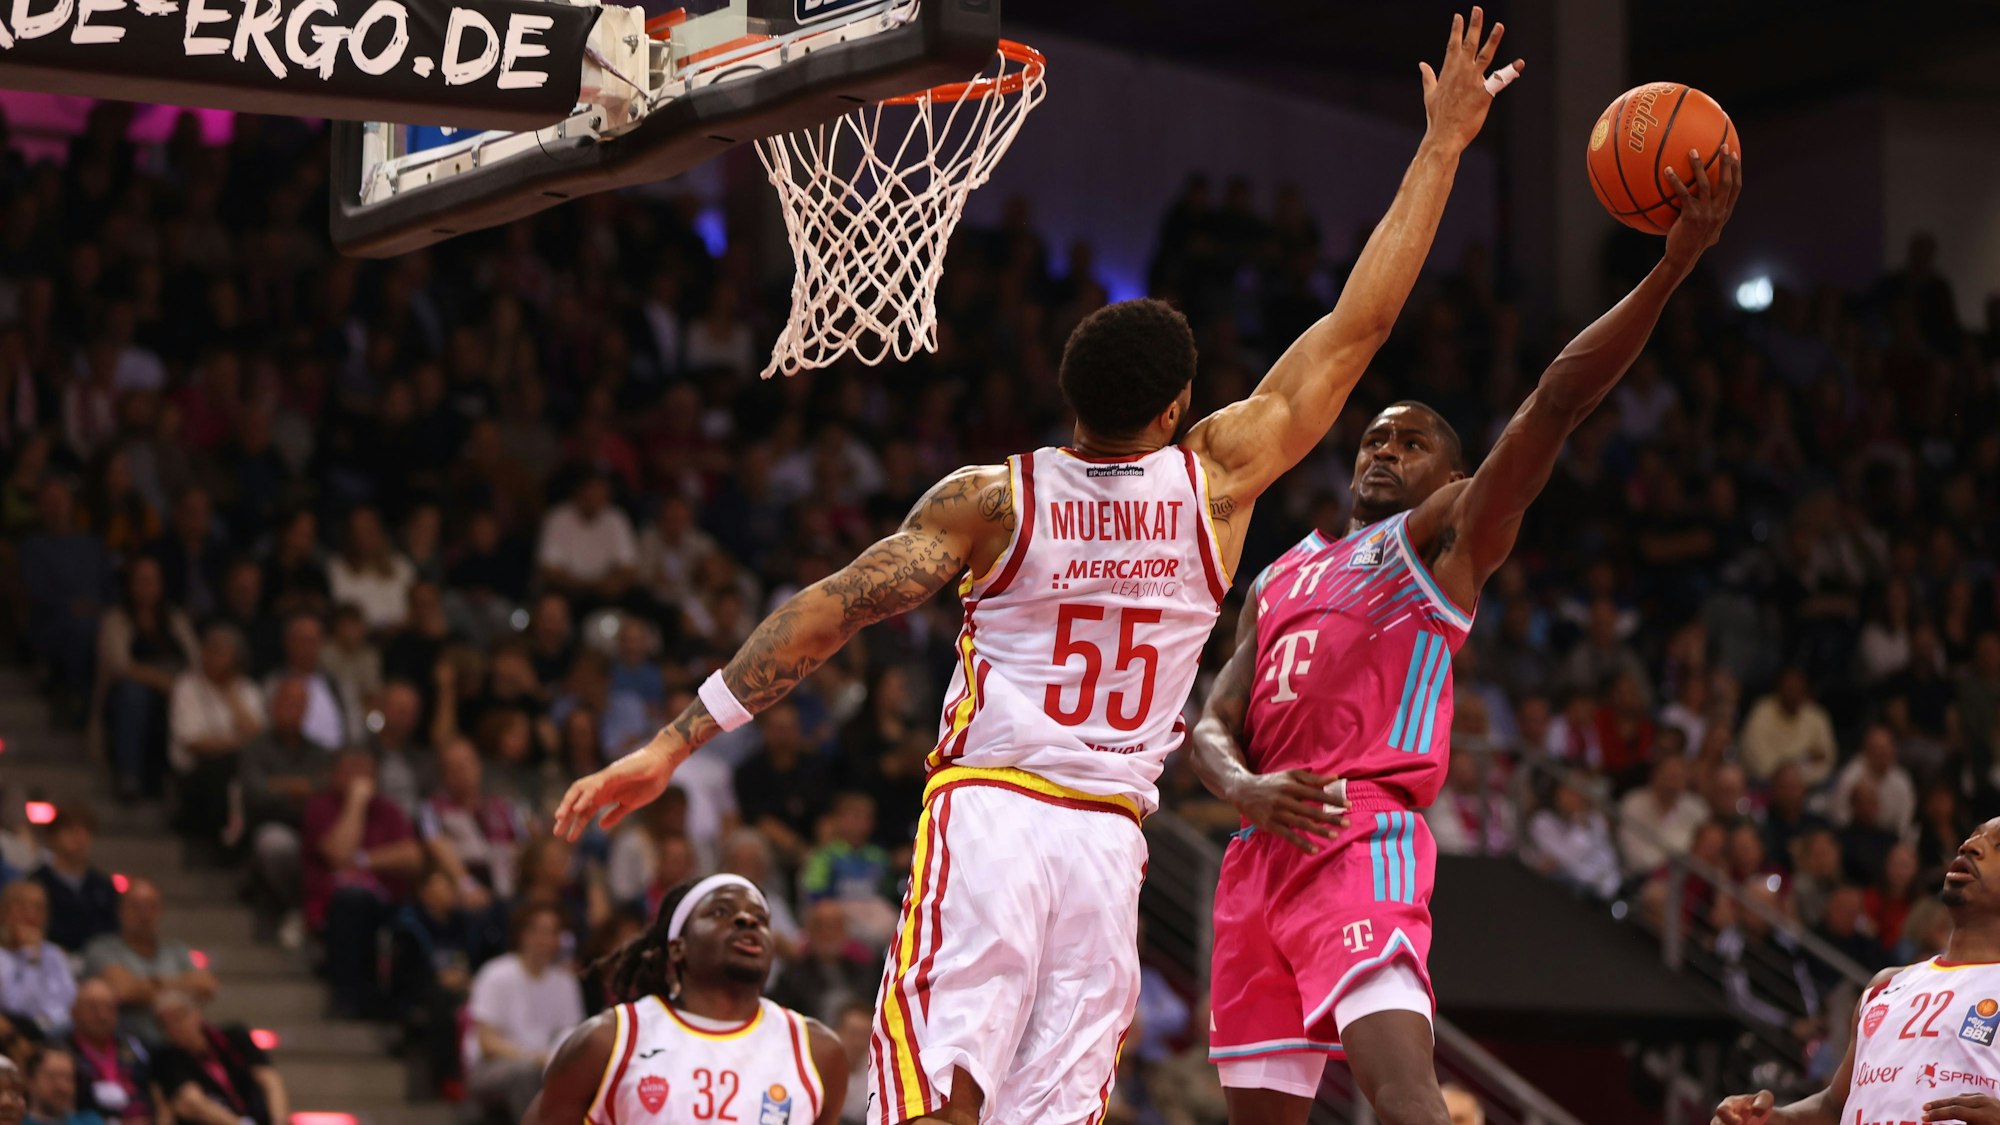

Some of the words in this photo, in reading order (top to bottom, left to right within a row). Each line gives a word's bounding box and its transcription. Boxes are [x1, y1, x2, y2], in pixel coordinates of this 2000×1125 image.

[0, 0, 554, 89] DE-ERGO.DE
[1050, 501, 1183, 541] MUENKAT
[1065, 558, 1179, 579] MERCATOR
[1288, 556, 1335, 600] 11
[1111, 581, 1176, 598] LEASING
[1044, 603, 1163, 731] 55
[1898, 990, 1955, 1040] 22
[1961, 1026, 1989, 1043] BBL
[1857, 1061, 1904, 1087] liver
[1939, 1070, 2000, 1090] SPRINT
[692, 1068, 739, 1122] 32
